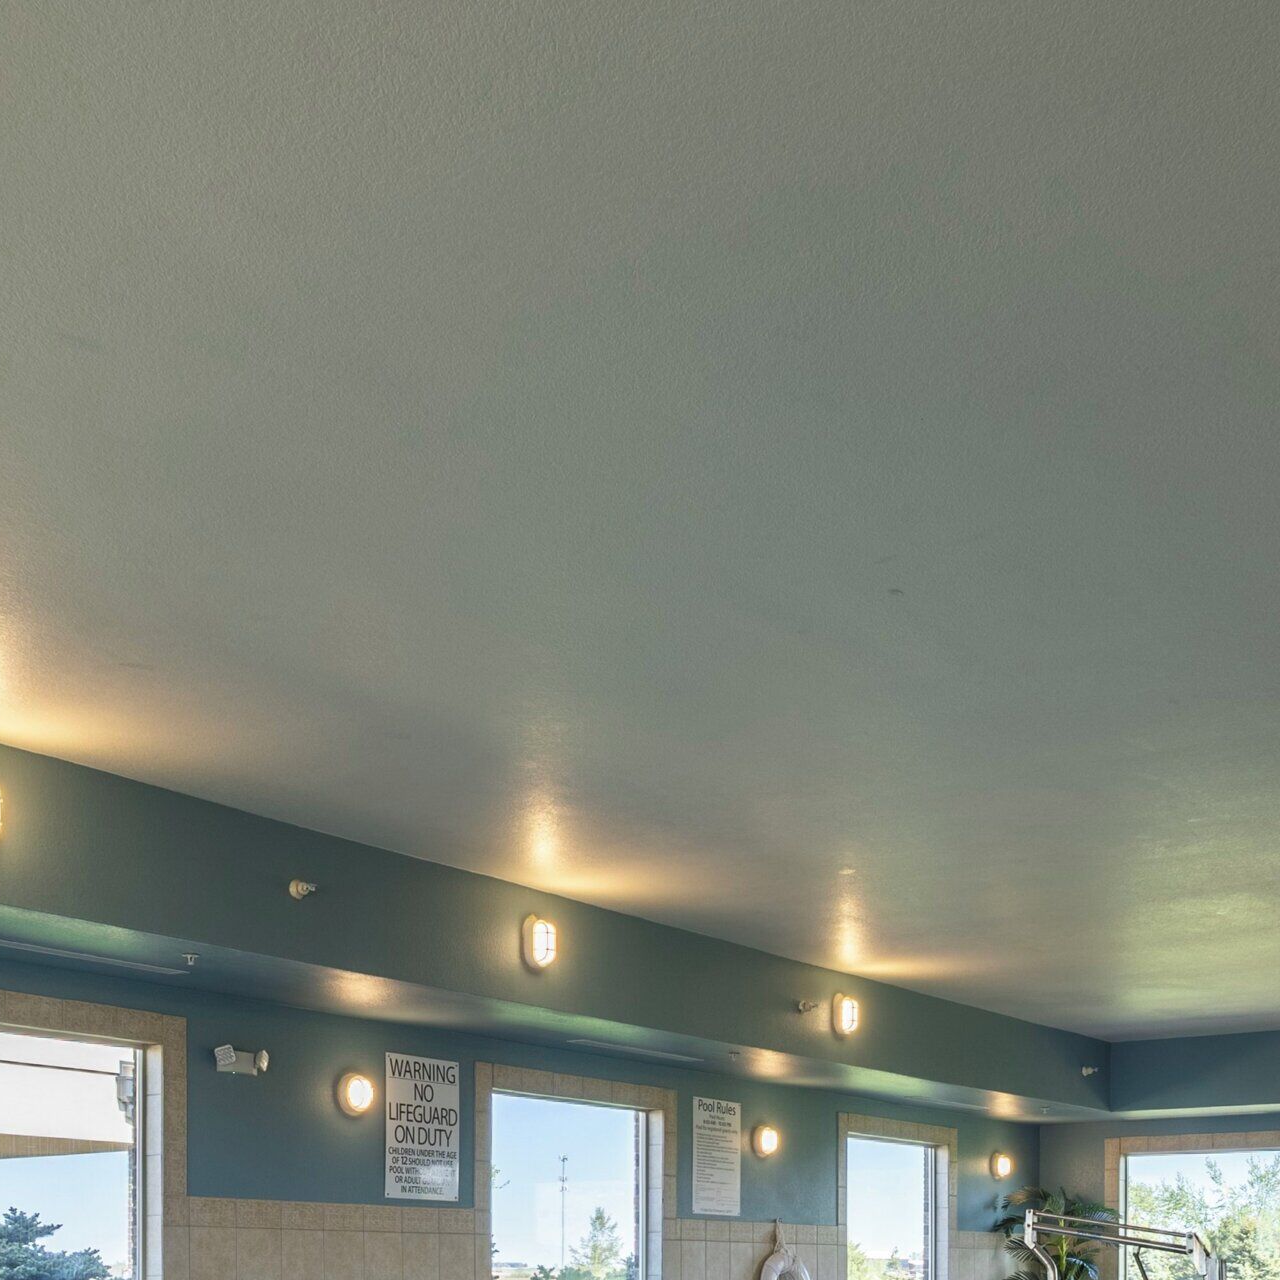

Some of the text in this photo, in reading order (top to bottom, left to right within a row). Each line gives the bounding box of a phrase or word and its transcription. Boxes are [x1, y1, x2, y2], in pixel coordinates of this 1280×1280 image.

[389, 1057, 456, 1084] WARNING
[414, 1083, 434, 1102] NO
[388, 1102, 458, 1127] LIFEGUARD
[698, 1099, 736, 1116] Pool Rules
[395, 1125, 452, 1147] ON DUTY
[388, 1146, 457, 1160] CHILDREN UNDER THE AGE
[392, 1156, 400, 1164] OF
[401, 1156, 408, 1165] 12
[409, 1157, 431, 1166] SHOULD
[389, 1166, 404, 1174] POOL
